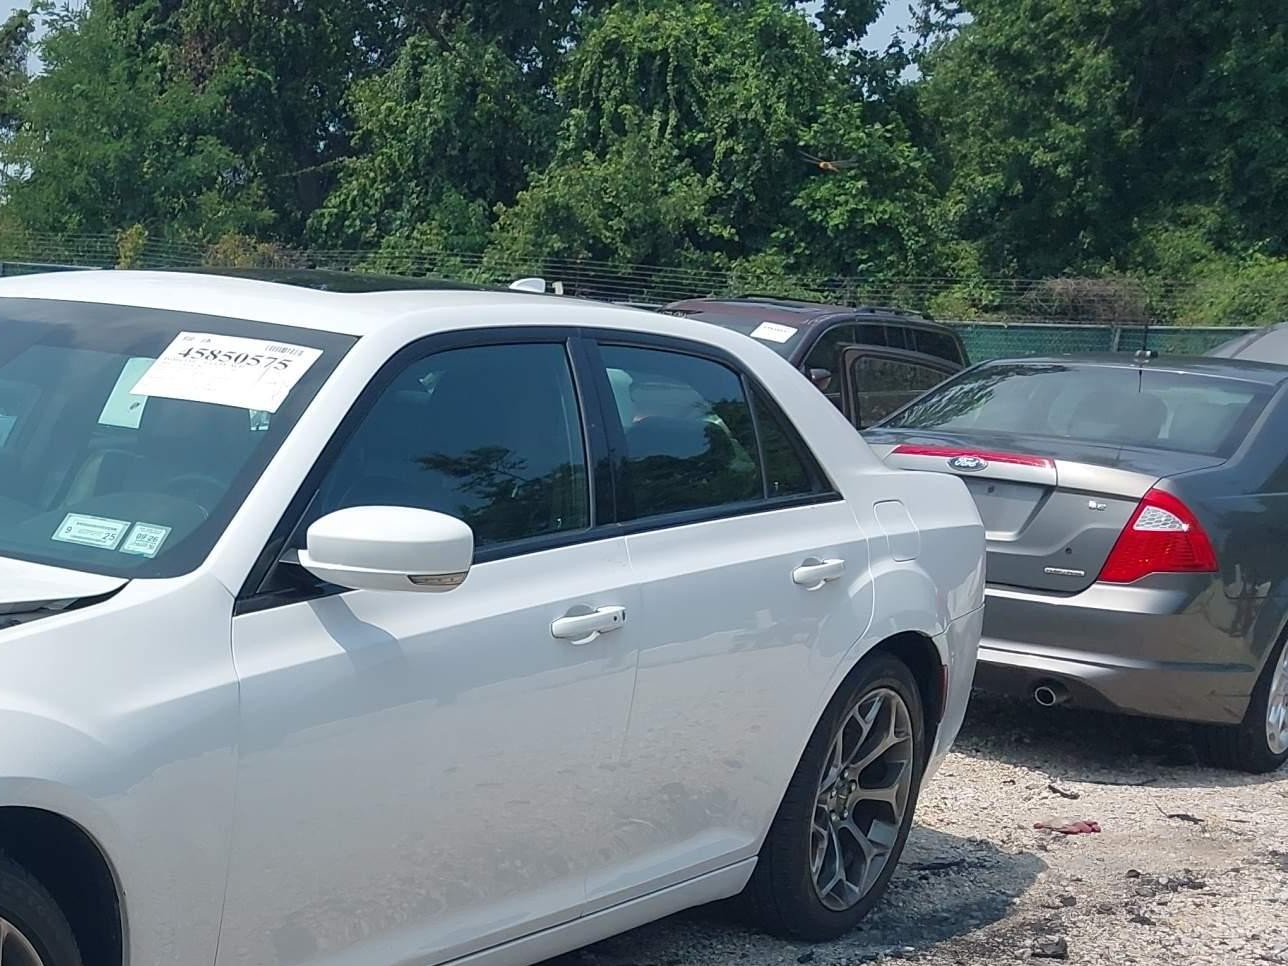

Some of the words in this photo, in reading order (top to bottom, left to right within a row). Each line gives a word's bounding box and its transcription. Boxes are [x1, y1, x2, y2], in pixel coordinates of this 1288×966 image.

[178, 346, 294, 371] 45850575
[954, 457, 979, 467] Ford
[64, 526, 73, 534] 9
[102, 532, 117, 541] 25
